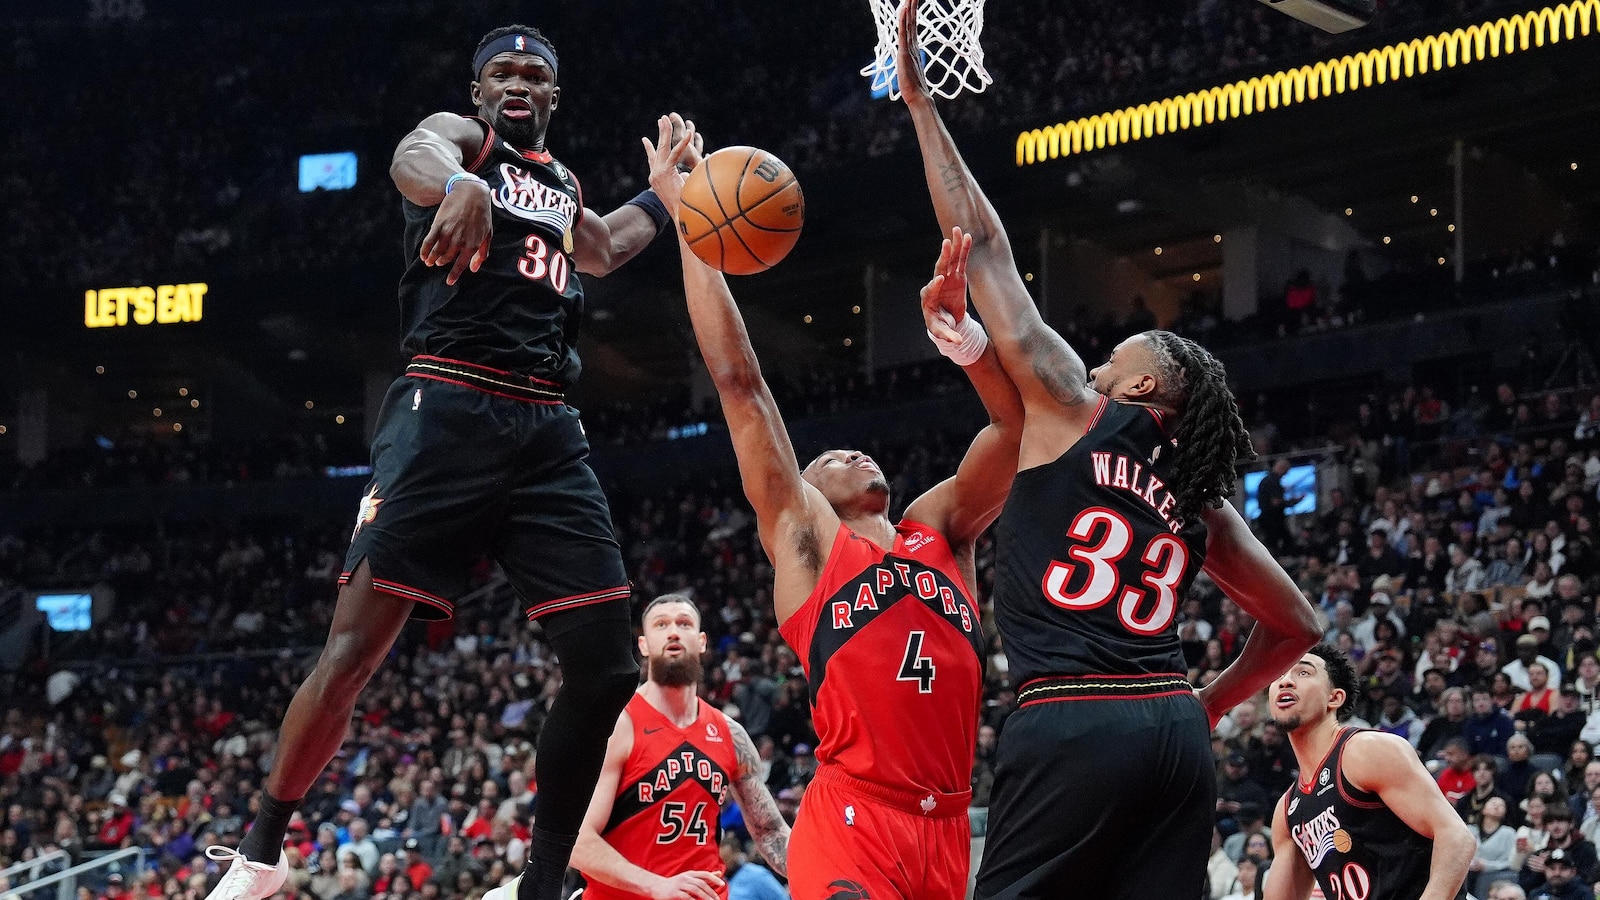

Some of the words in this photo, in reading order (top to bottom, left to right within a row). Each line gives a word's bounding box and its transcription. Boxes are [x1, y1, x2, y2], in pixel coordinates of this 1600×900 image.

[517, 233, 569, 295] 30
[84, 286, 156, 328] LET'S
[156, 282, 208, 324] EAT
[831, 562, 973, 632] RAPTORS
[1041, 505, 1189, 636] 33
[895, 630, 936, 694] 4
[638, 751, 728, 806] RAPTORS
[655, 801, 709, 846] 54
[1328, 861, 1371, 900] 20
